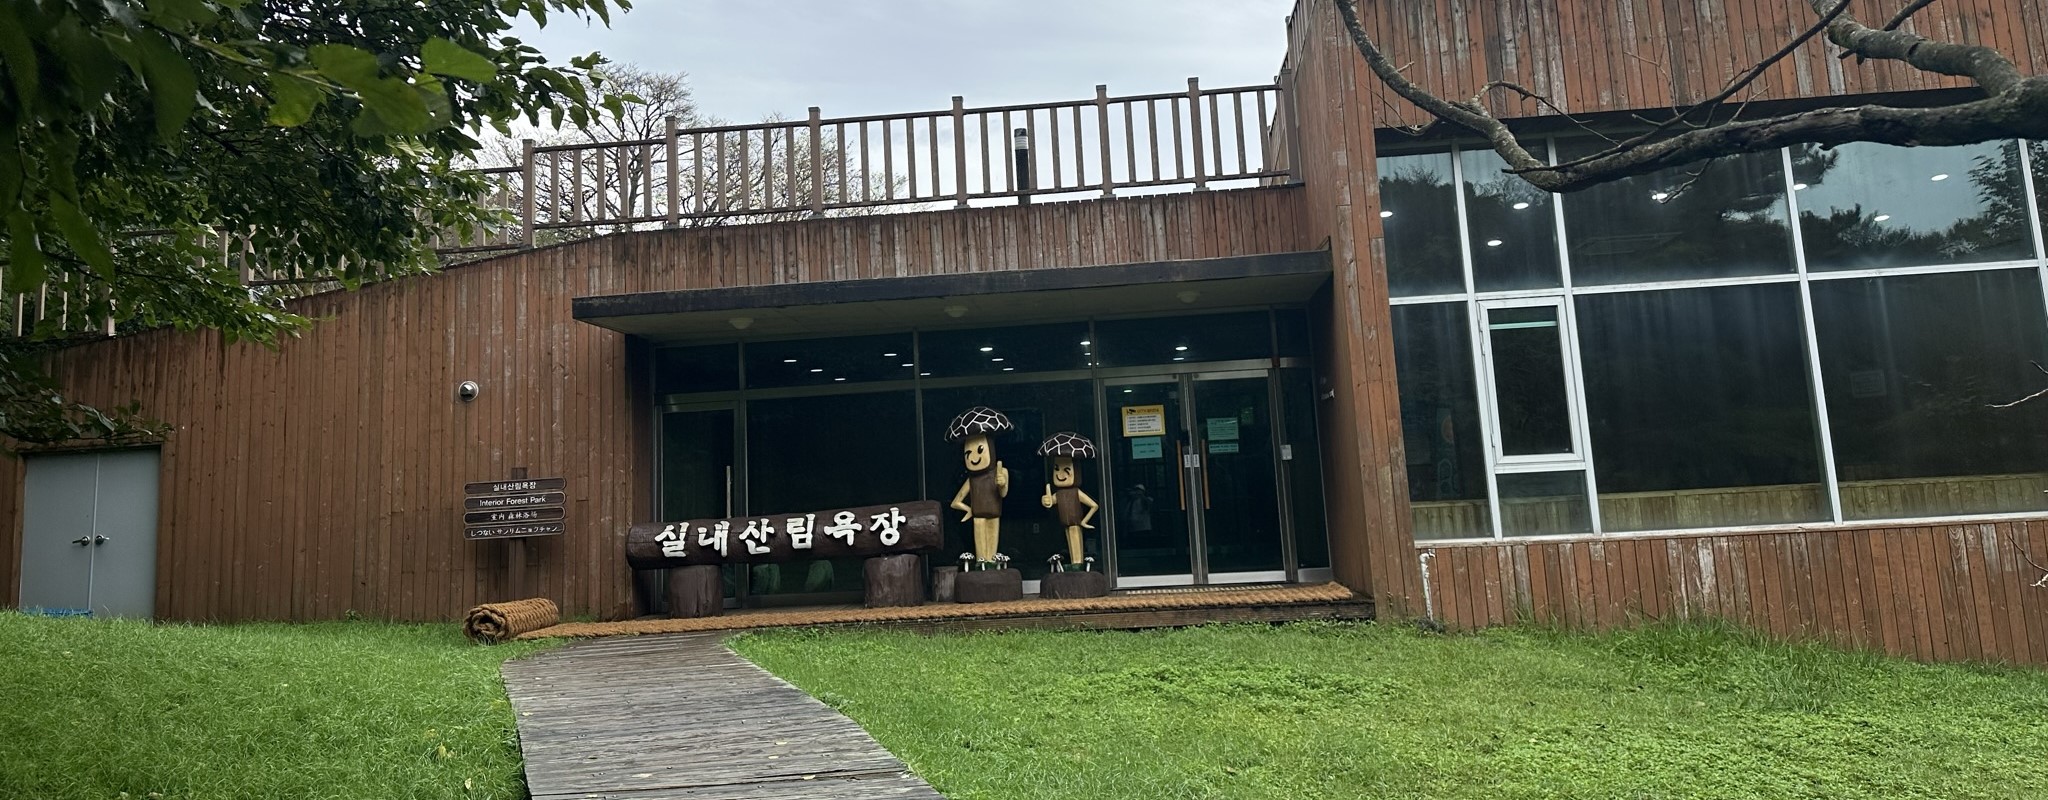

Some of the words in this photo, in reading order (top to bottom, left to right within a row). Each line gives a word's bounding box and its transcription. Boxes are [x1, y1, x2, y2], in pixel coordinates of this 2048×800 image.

[493, 482, 536, 491] 실내산림욕장
[506, 497, 528, 505] Forest
[530, 495, 546, 503] Park
[470, 529, 495, 537] しつない
[654, 507, 907, 557] 실내산림욕장
